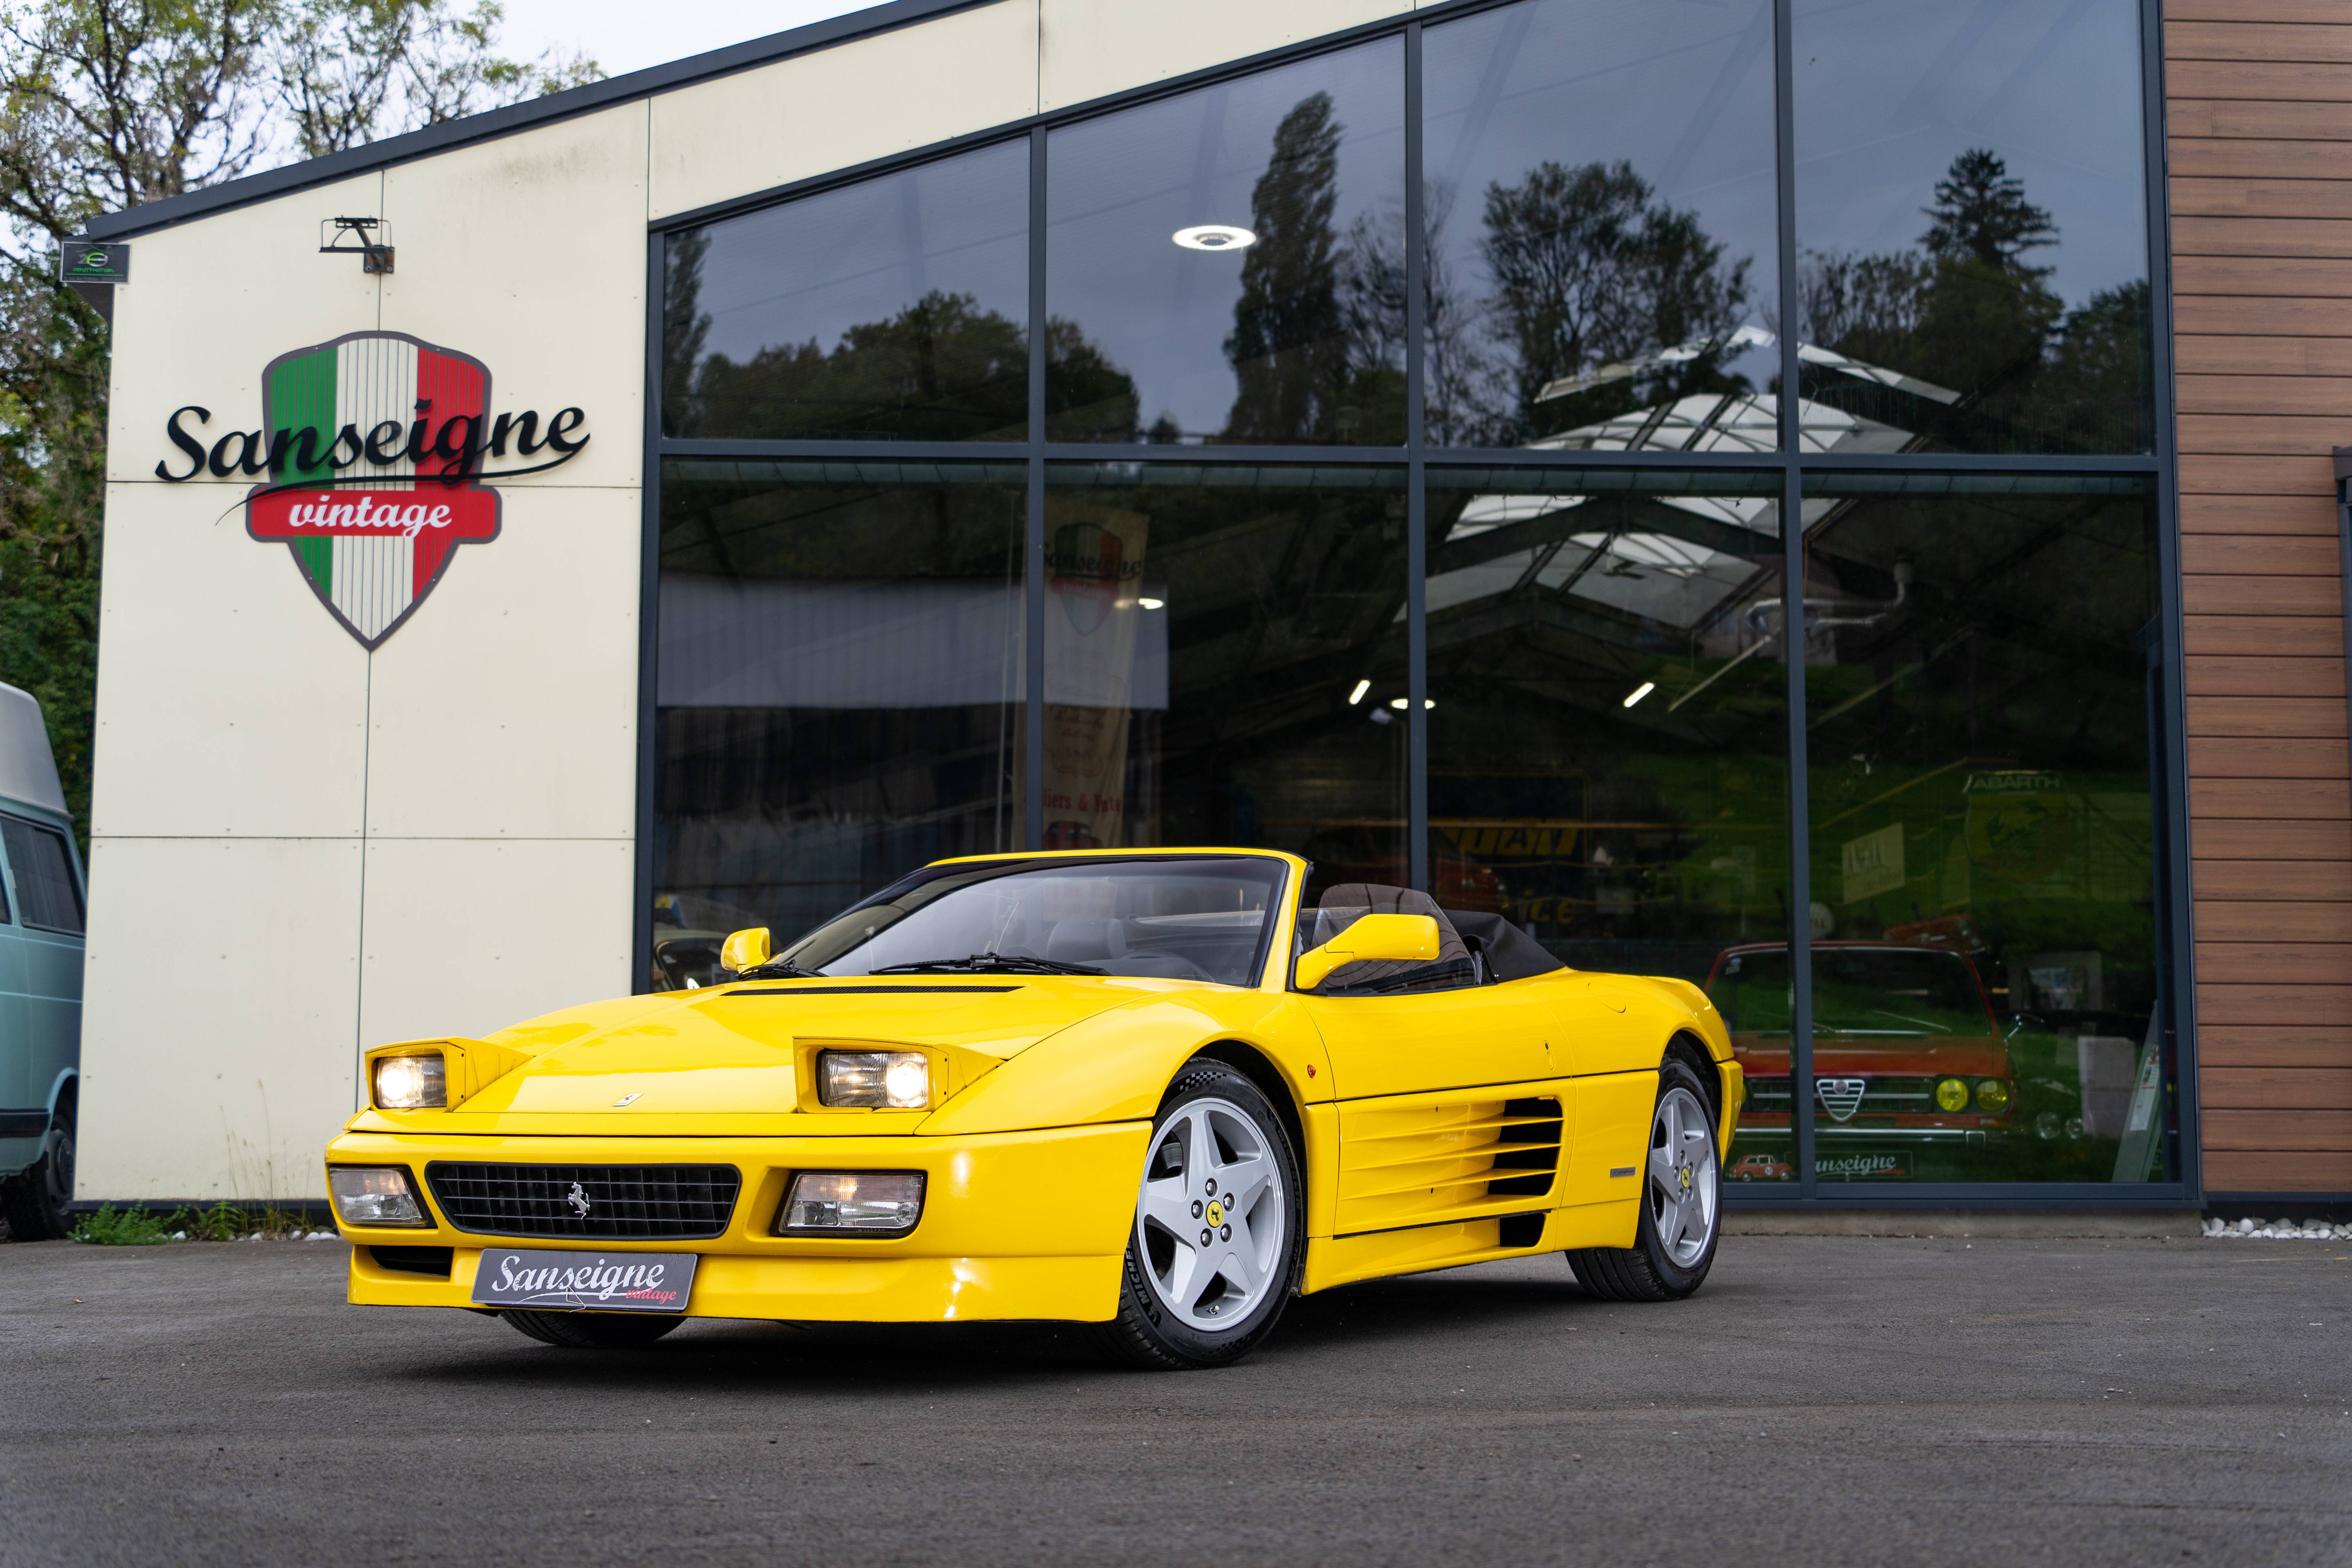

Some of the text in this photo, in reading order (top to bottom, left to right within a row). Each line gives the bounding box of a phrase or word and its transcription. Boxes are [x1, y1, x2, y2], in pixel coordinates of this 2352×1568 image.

[155, 399, 590, 485] Sanseigne
[288, 495, 452, 539] vintage
[1973, 776, 2060, 789] ABARTH
[491, 1255, 665, 1300] Sanseigne
[1125, 1240, 1150, 1304] MICHEL
[625, 1286, 676, 1304] vintage
